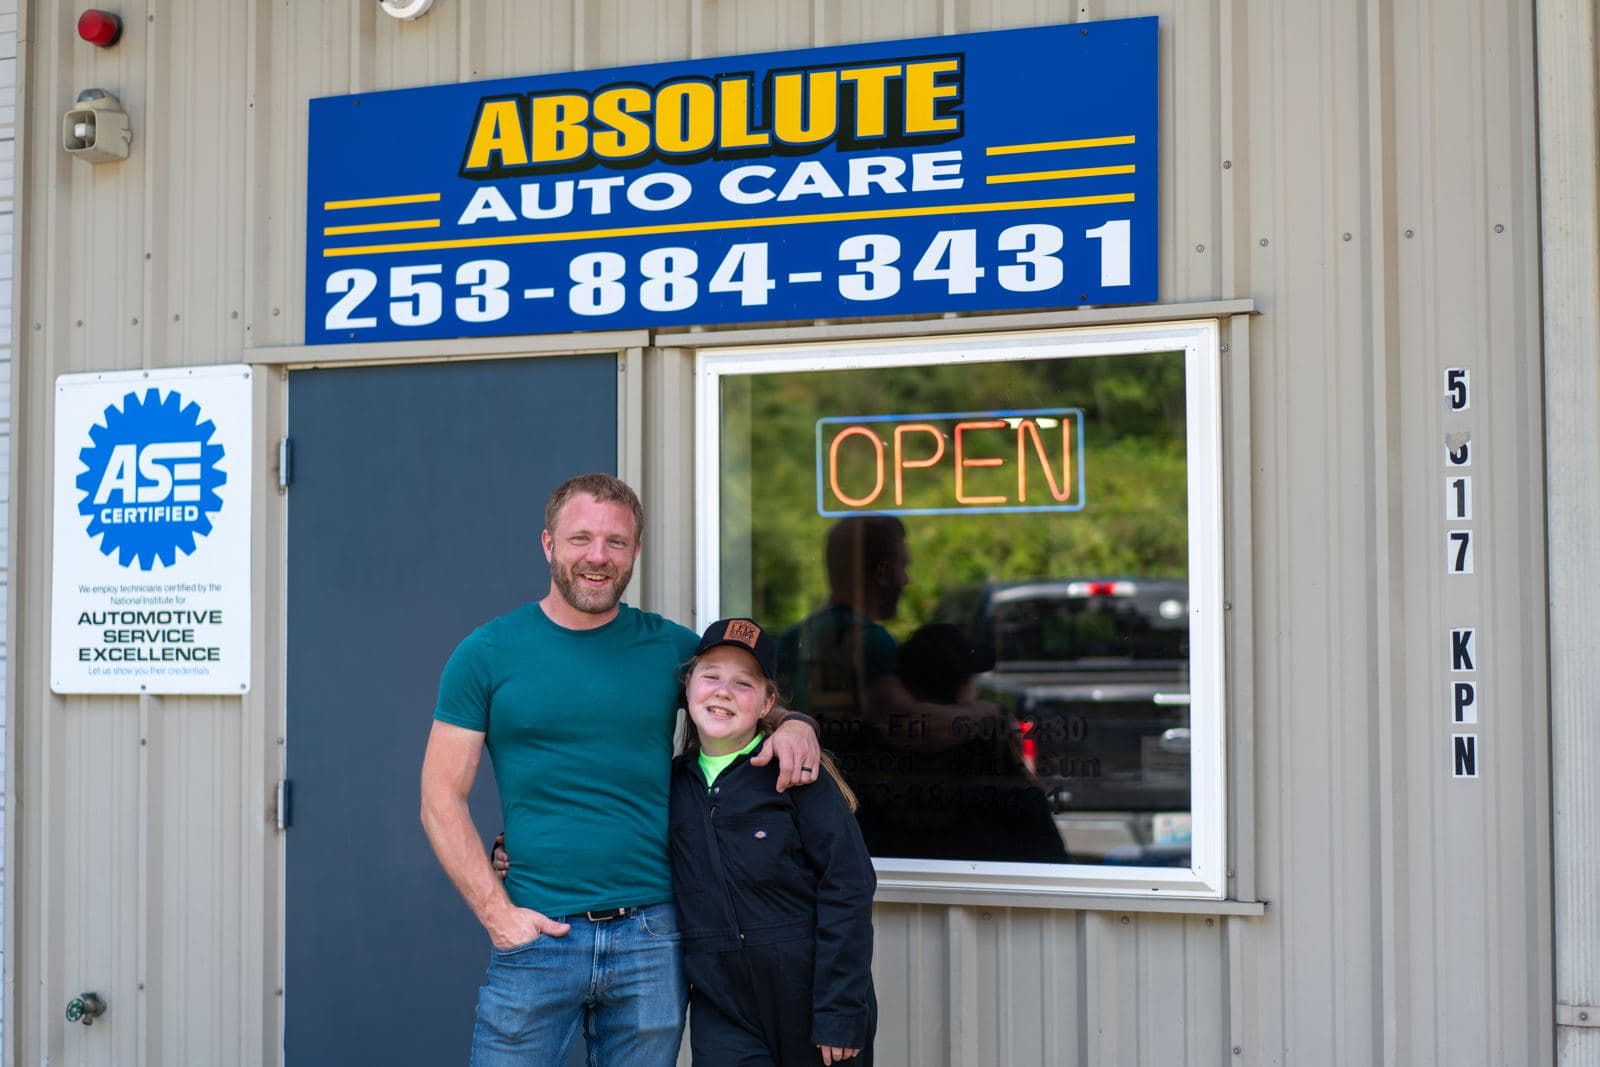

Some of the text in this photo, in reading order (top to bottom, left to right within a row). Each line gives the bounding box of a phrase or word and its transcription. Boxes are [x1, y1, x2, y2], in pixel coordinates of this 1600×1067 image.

[465, 60, 959, 169] ABSOLUTE
[458, 150, 964, 225] AUTO CARE
[325, 219, 1131, 330] 253-884-3431
[93, 441, 202, 505] ASE
[829, 417, 1072, 507] OPEN
[100, 505, 199, 524] CERTIFIED
[79, 582, 222, 595] We employ technicians certified by the
[111, 595, 186, 605] National Institute for
[77, 610, 223, 626] AUTOMOTIVE
[103, 629, 195, 643] SERVICE
[78, 647, 221, 661] EXCELLENCE
[88, 665, 210, 677] Let us show you their credentials
[1452, 631, 1476, 776] KPN
[888, 712, 929, 738] Fri
